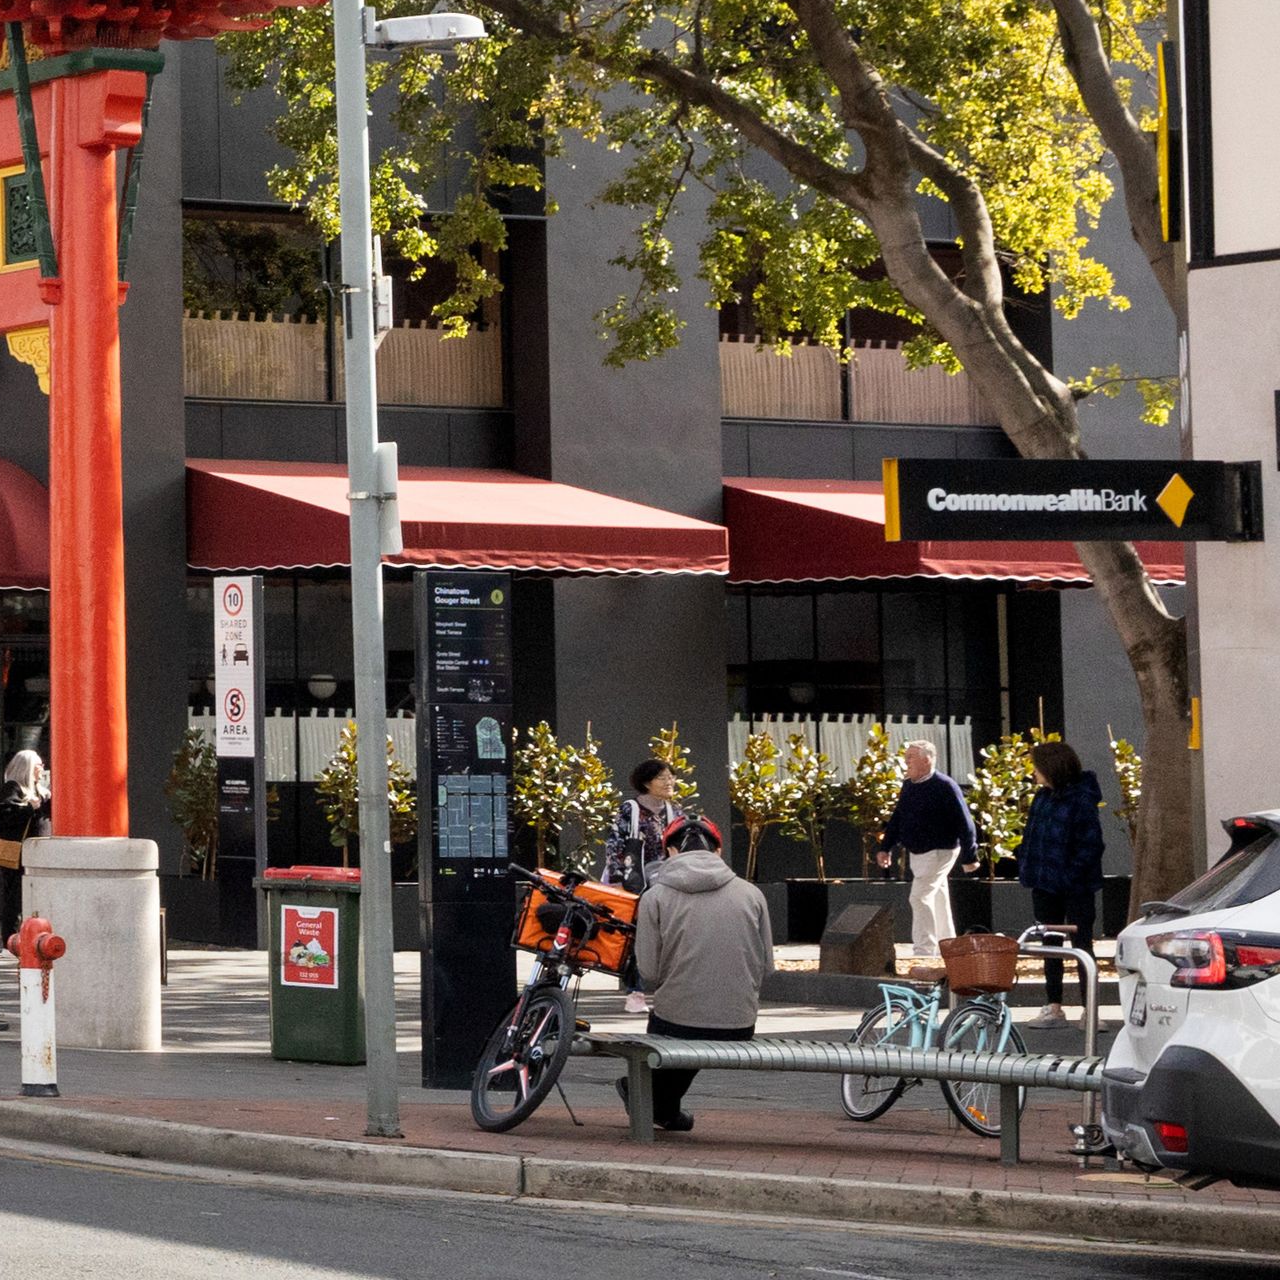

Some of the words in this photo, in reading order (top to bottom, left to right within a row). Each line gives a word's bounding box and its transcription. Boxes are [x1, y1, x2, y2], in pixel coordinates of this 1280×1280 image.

[926, 487, 1148, 512] CommonwealthBank
[434, 587, 470, 595] Chinatown
[228, 593, 239, 607] 10
[434, 597, 459, 605] Gouger
[460, 597, 480, 605] Street
[221, 619, 247, 628] SHARED
[225, 631, 242, 640] ZONE
[223, 725, 248, 735] AREA
[296, 921, 322, 929] General
